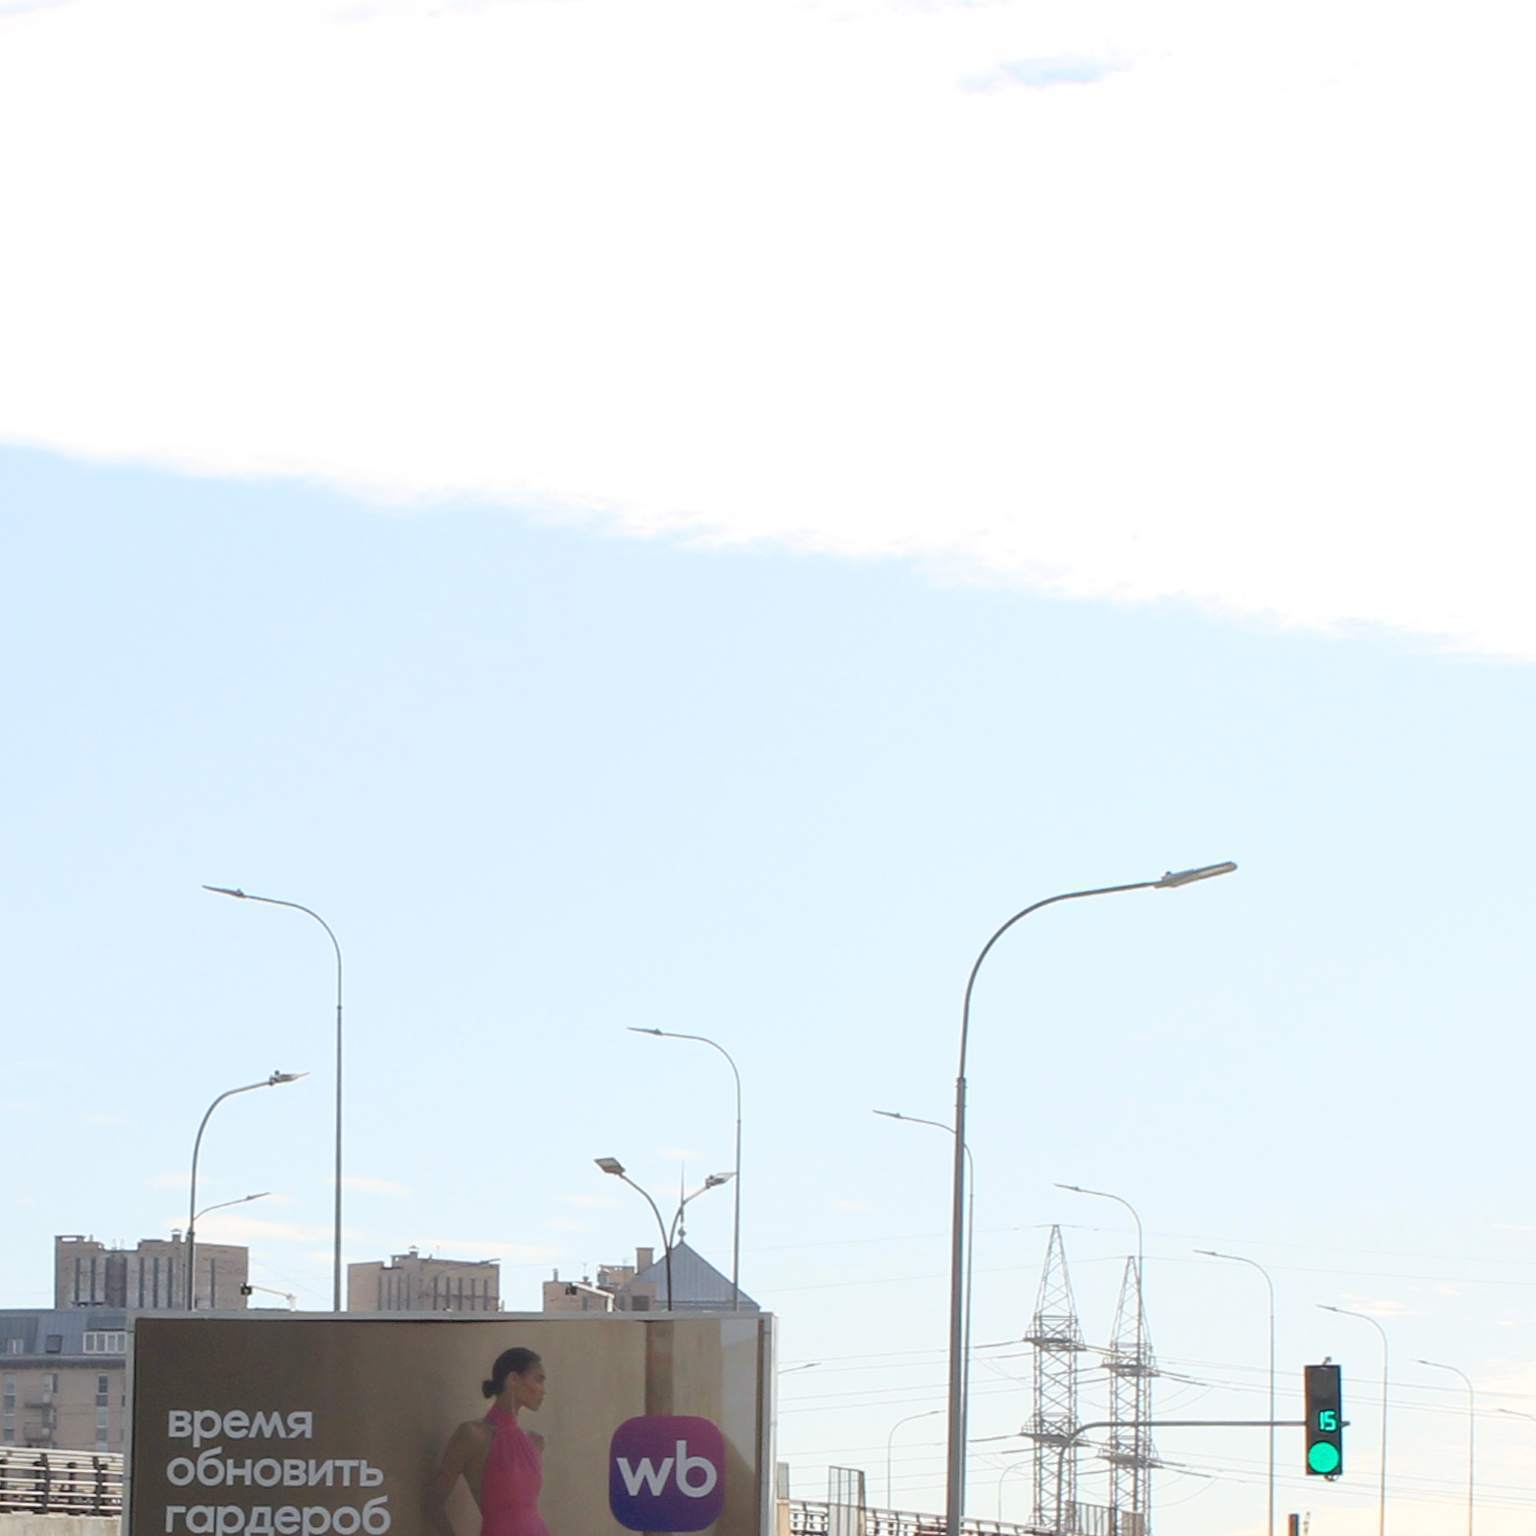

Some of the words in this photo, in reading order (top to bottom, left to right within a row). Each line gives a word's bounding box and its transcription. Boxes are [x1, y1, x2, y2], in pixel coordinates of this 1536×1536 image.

[168, 1409, 313, 1448] время
[1319, 1410, 1336, 1431] 15
[166, 1446, 384, 1487] обновить
[616, 1439, 717, 1498] wb
